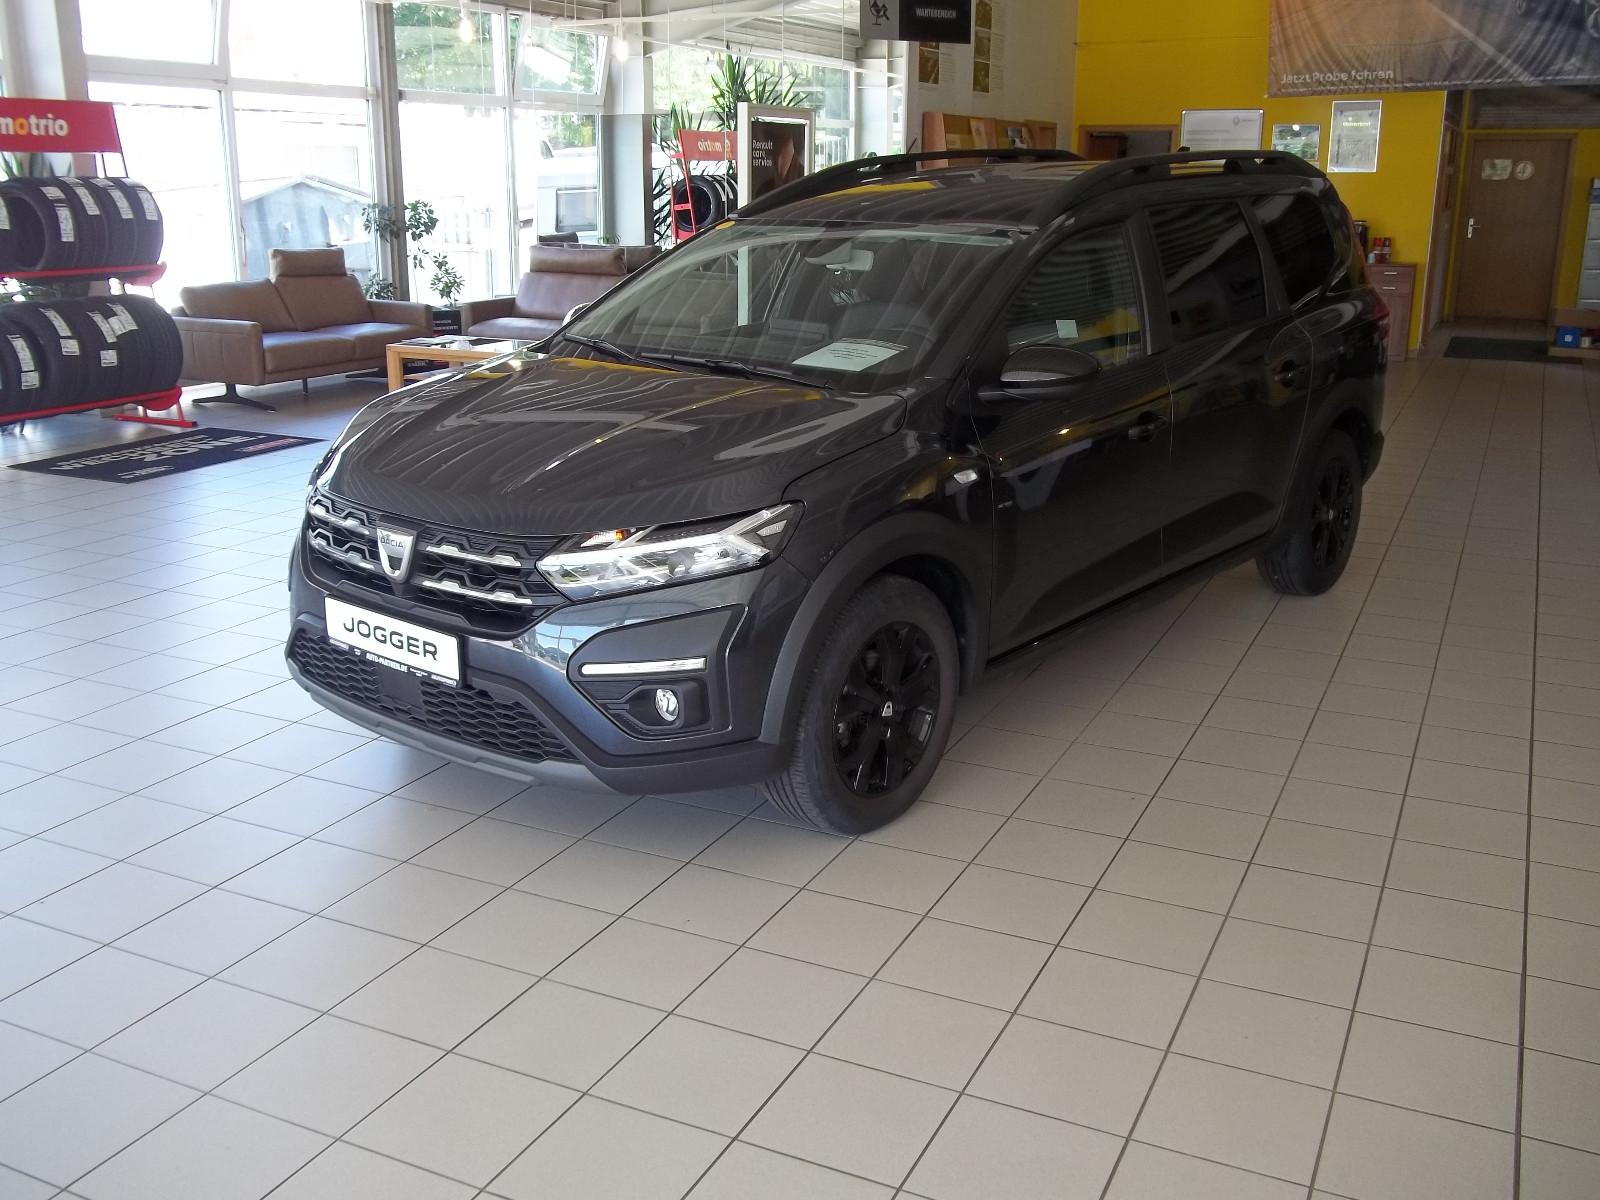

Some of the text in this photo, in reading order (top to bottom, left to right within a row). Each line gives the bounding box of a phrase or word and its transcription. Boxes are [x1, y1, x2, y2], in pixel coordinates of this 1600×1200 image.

[1281, 69, 1394, 84] Jetzt Probe fahren
[0, 113, 69, 136] motrio
[752, 139, 773, 150] Renault
[752, 150, 766, 158] care
[752, 157, 773, 167] service
[380, 536, 404, 548] DACIA
[343, 617, 438, 661] JOGGER
